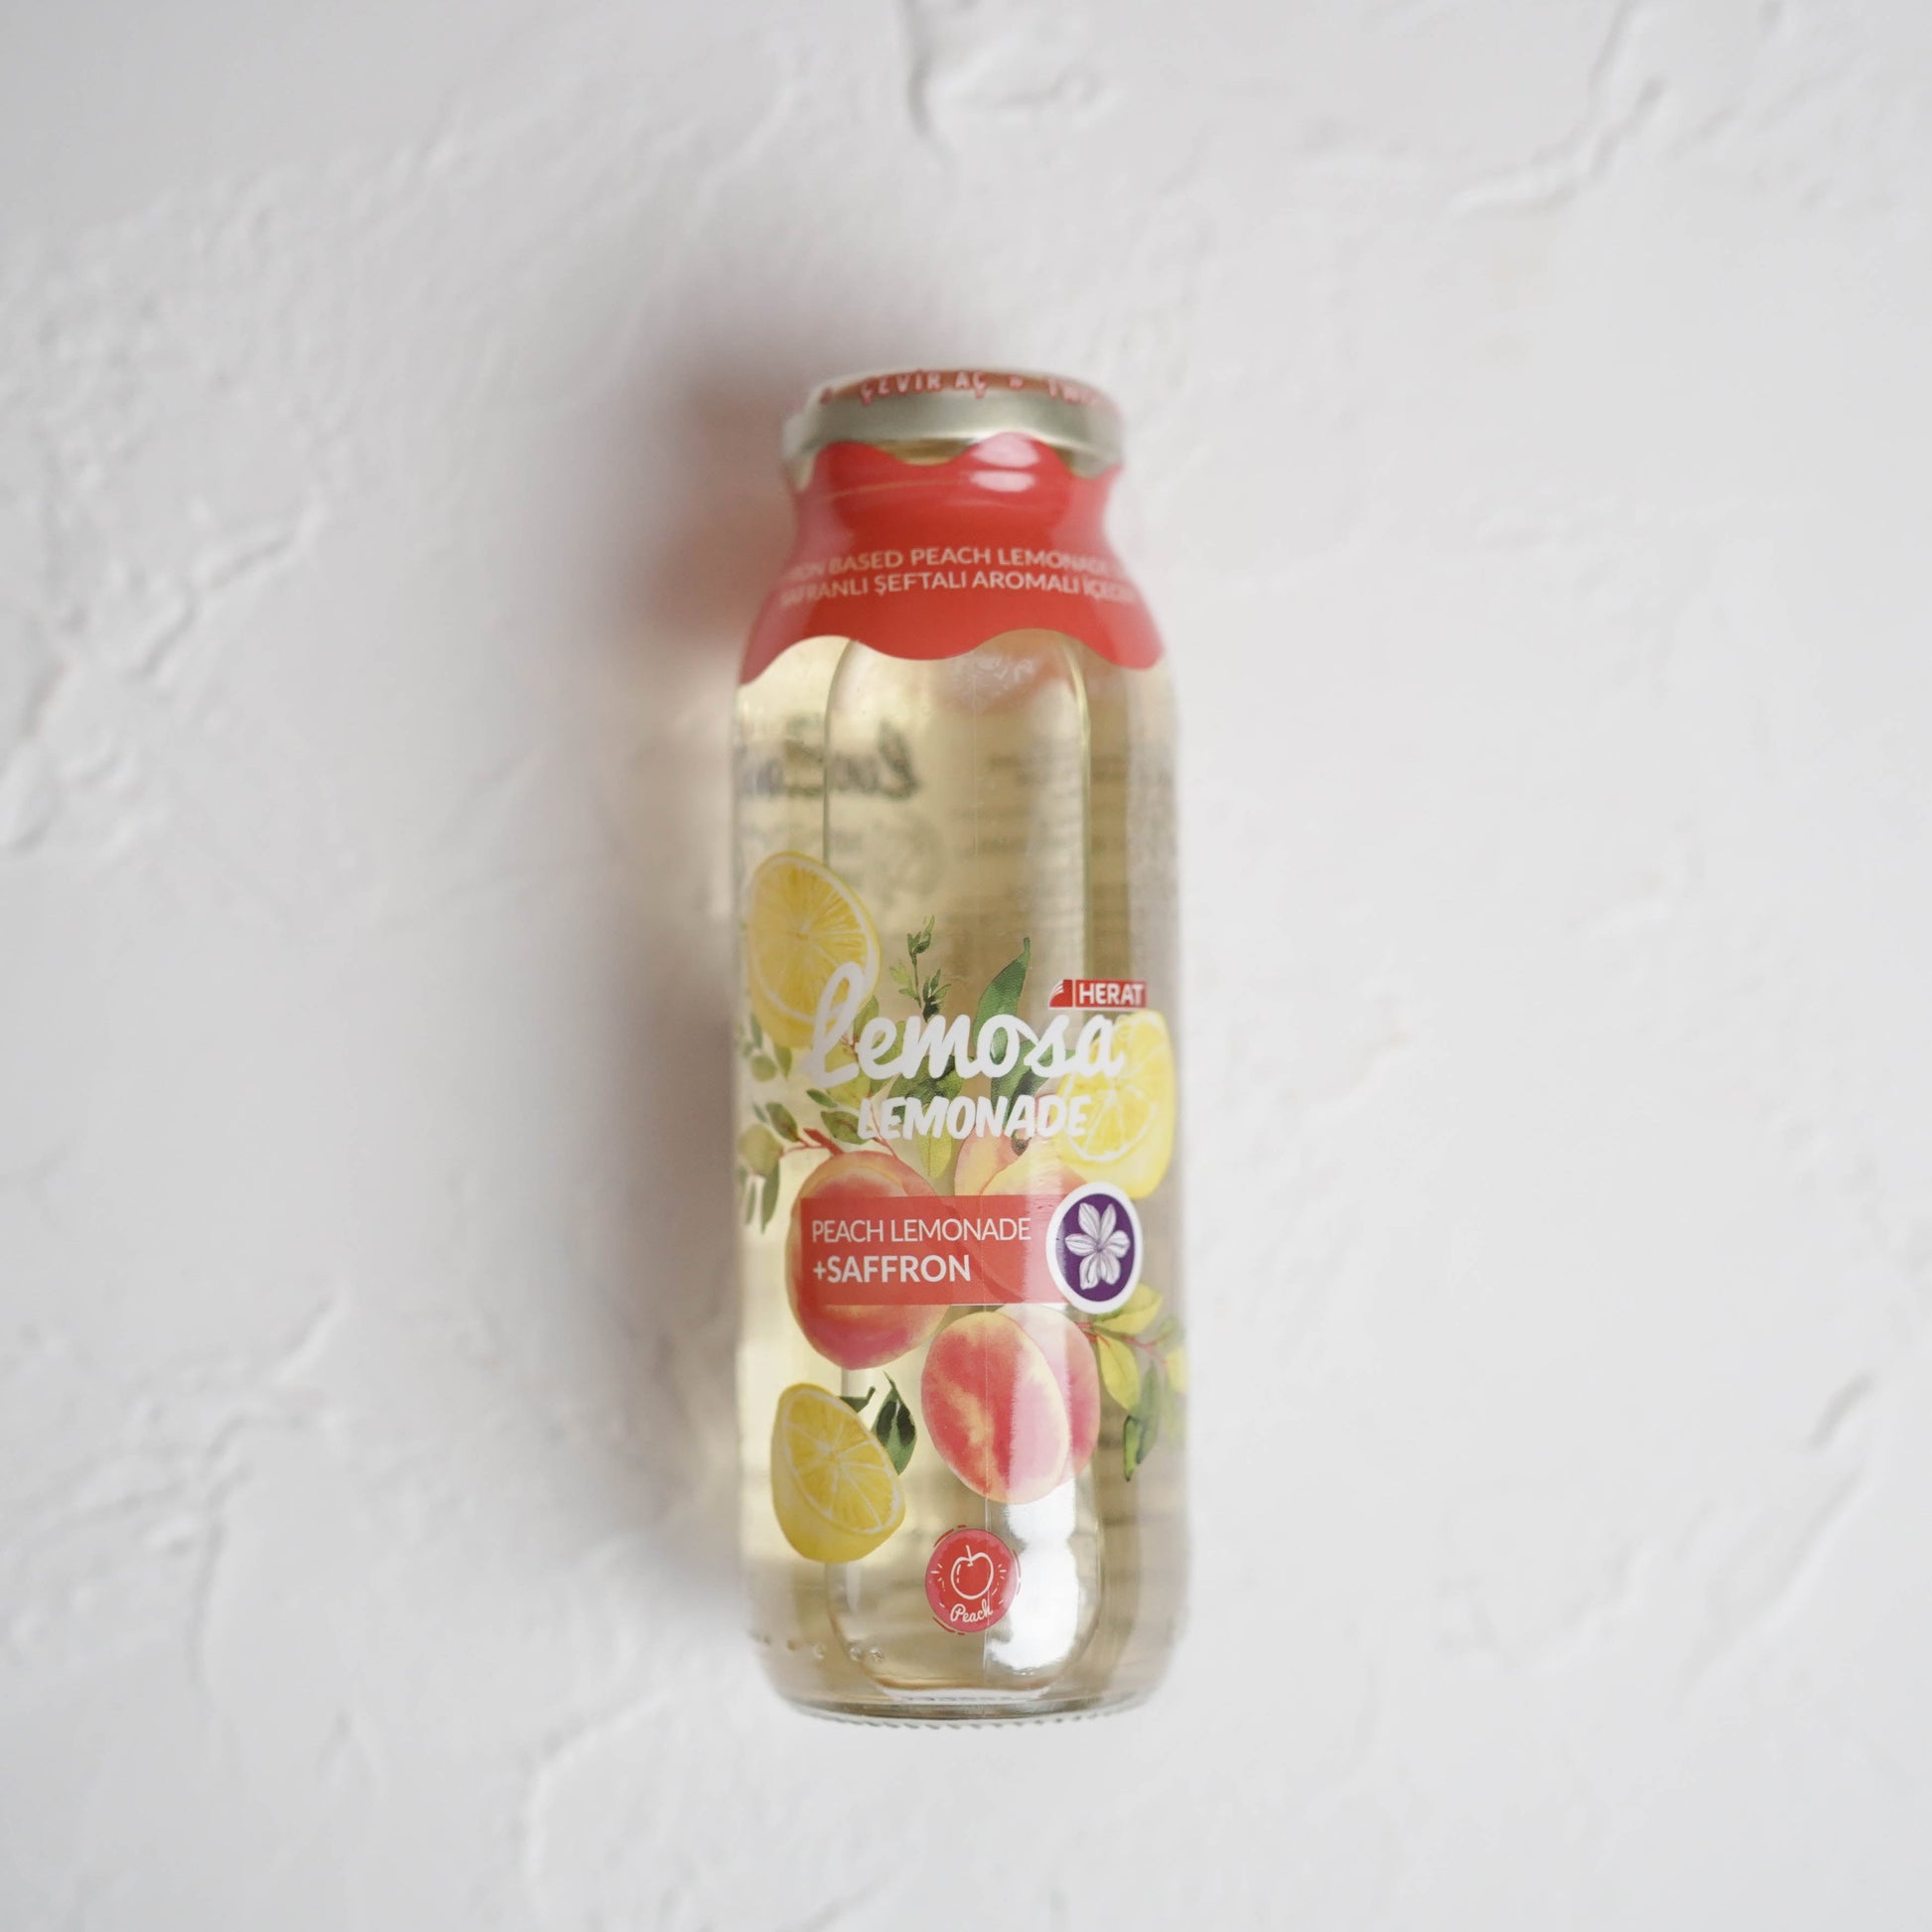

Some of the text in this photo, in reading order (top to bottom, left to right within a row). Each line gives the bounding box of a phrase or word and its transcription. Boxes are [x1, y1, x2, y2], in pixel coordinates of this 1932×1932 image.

[954, 370, 987, 400] AÇ
[828, 549, 904, 575] BASED
[910, 546, 991, 569] PEACH
[998, 547, 1107, 576] LEMONA
[778, 577, 869, 609] RANLI
[875, 571, 967, 598] ŞEFTALI
[972, 570, 1079, 594] AROMALI
[1078, 982, 1144, 1006] HERAT
[858, 1094, 1093, 1141] LEMONADE
[812, 1217, 1032, 1243] PEACH LEMONADE
[813, 1255, 971, 1283] +SAFFRON
[950, 1598, 994, 1623] Peach
